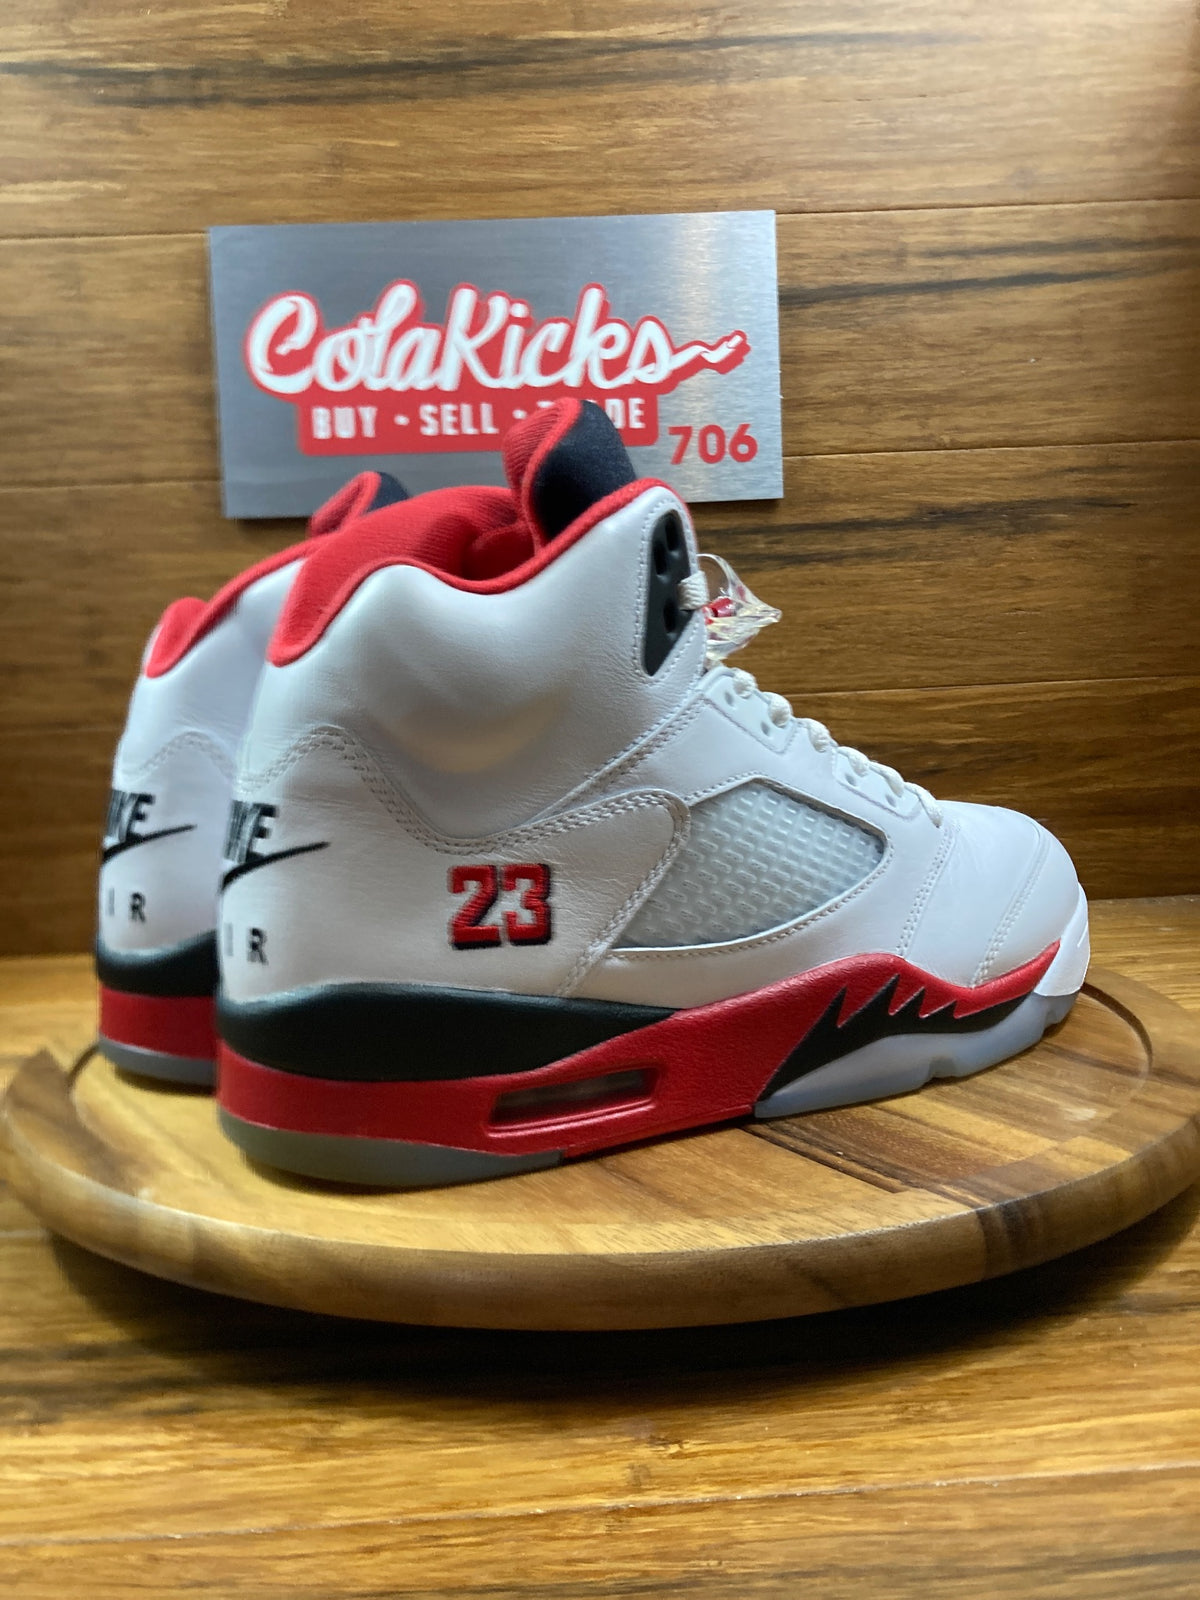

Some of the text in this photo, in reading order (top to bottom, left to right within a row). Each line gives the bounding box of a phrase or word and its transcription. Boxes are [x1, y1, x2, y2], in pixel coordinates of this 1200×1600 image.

[246, 281, 746, 395] ColaKicks
[311, 405, 377, 439] BUY
[419, 402, 499, 436] SELL
[668, 423, 758, 465] 706
[447, 863, 552, 950] 23
